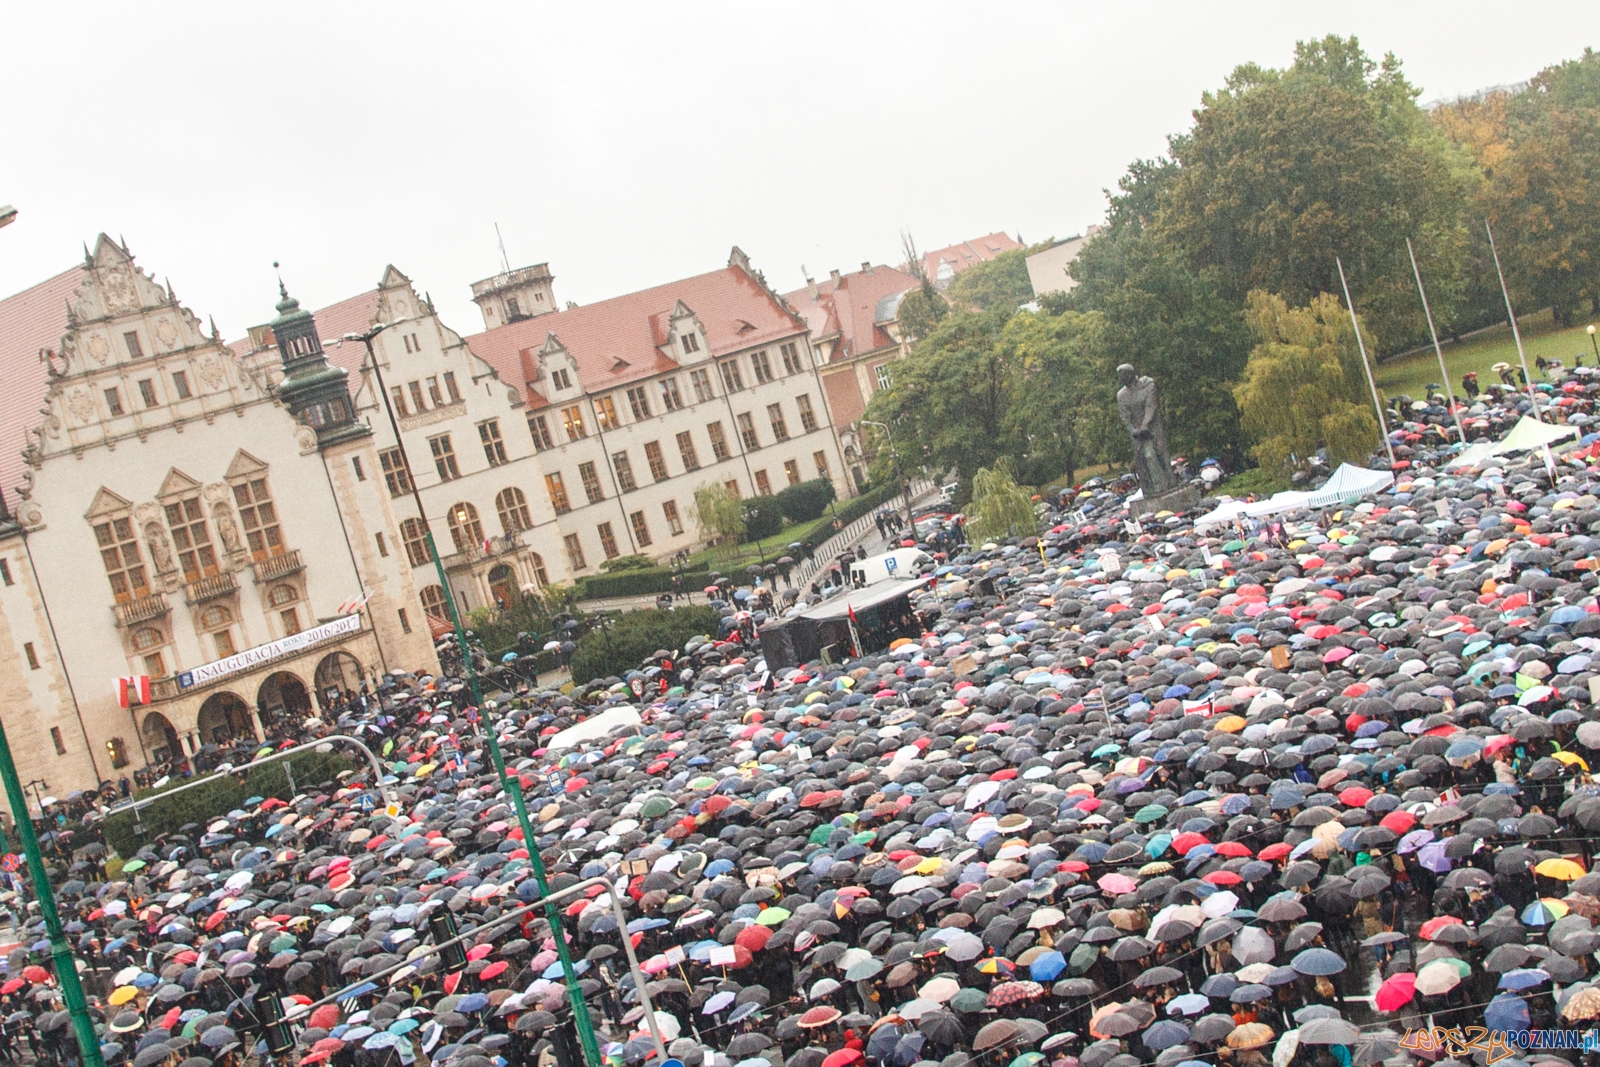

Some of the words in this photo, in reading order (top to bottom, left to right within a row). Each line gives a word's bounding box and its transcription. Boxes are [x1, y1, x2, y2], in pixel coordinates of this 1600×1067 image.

[195, 643, 282, 680] INAUGURACJA
[282, 634, 305, 648] ROKU
[307, 617, 358, 643] 2016/2017
